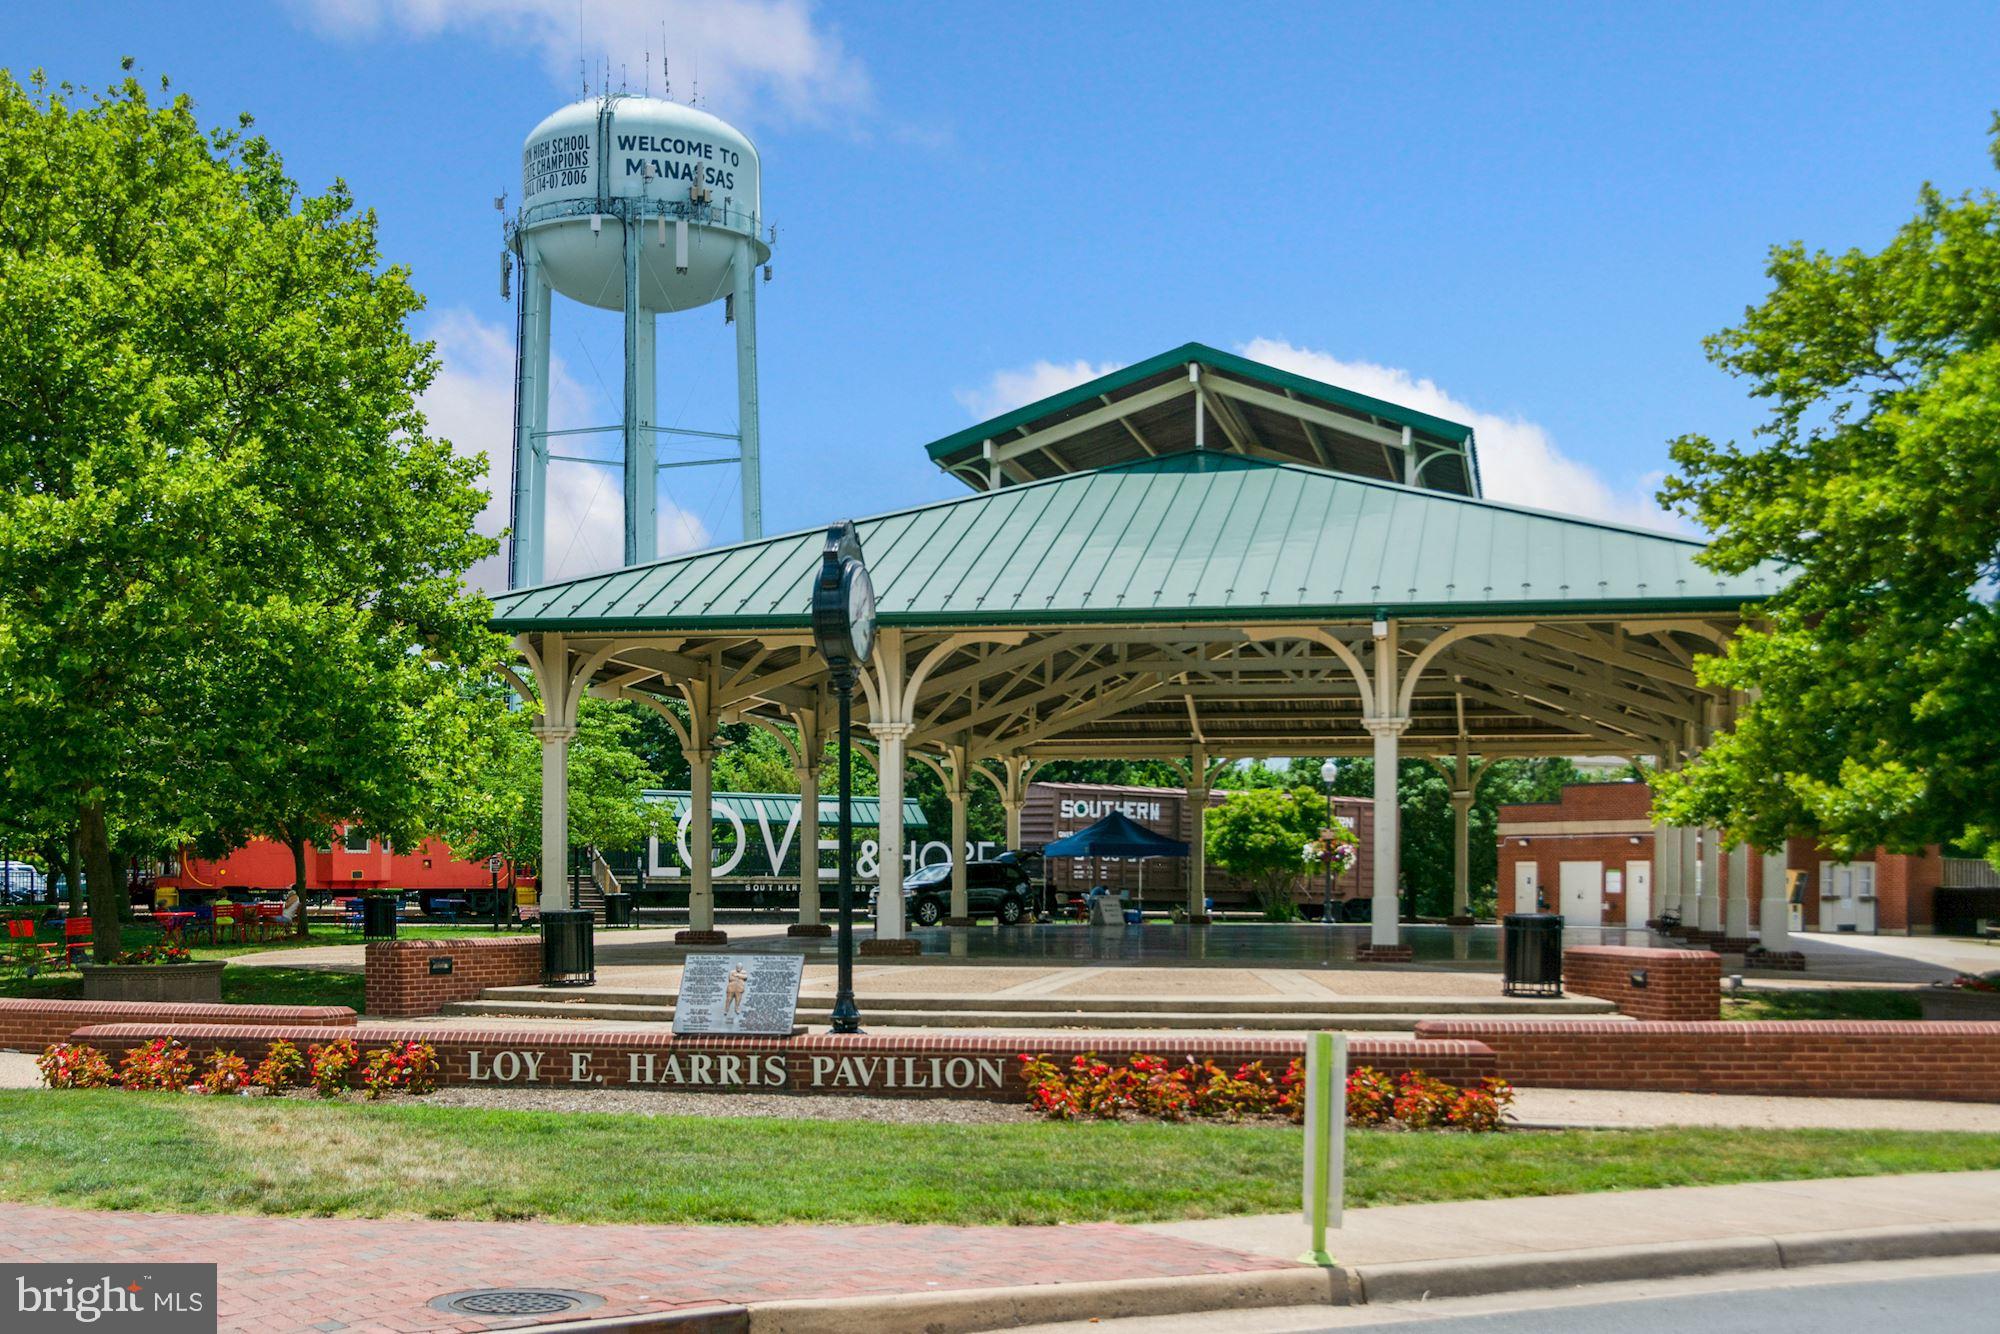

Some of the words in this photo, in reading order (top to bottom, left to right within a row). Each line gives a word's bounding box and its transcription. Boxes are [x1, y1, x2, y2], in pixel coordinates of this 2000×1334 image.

[533, 140, 550, 161] HIGH
[552, 134, 591, 155] SCHOOL
[617, 135, 713, 160] WELCOME
[719, 147, 740, 168] TO
[536, 150, 589, 175] CHAMPIONS
[561, 169, 587, 187] 2006
[1060, 799, 1161, 820] SOUTHERN
[745, 884, 800, 892] SOUTHER
[467, 1050, 545, 1081] LOY
[570, 1052, 603, 1082] E.
[628, 1053, 787, 1085] HARRIS
[811, 1055, 1005, 1088] PAVILION
